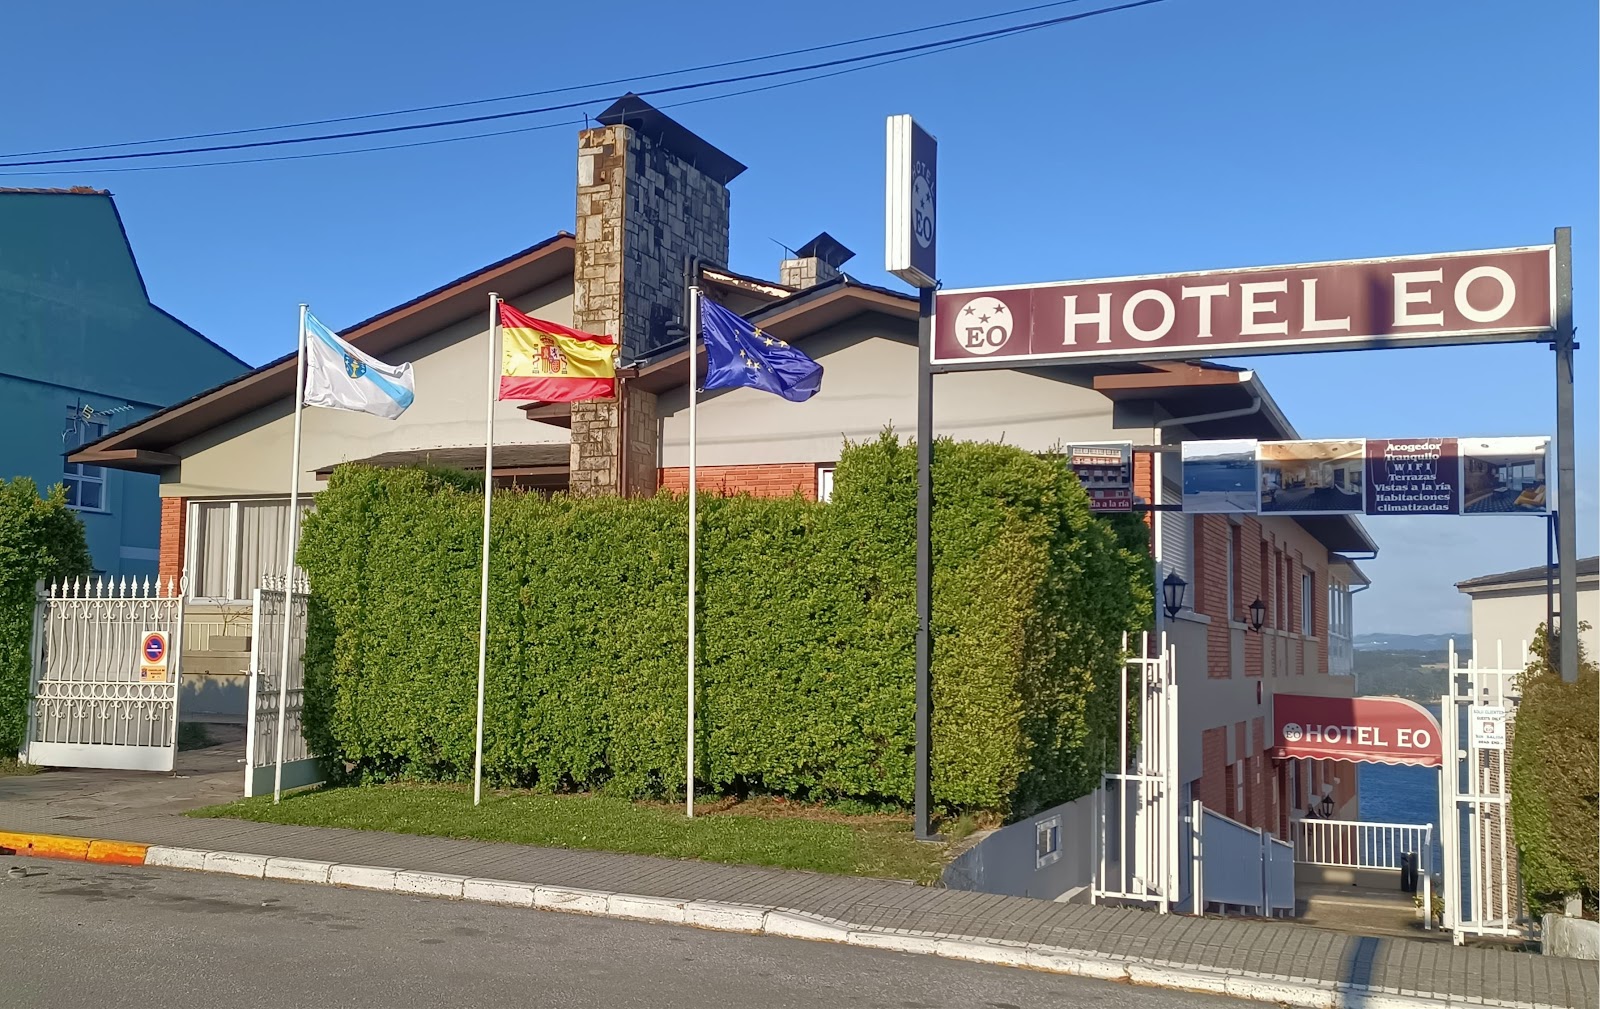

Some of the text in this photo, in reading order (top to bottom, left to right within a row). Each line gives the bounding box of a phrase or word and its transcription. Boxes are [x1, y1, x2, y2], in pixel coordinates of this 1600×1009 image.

[912, 160, 935, 196] HOTEL
[915, 208, 932, 242] EO
[1062, 265, 1516, 346] HOTEL EO
[965, 324, 1008, 348] EO
[1387, 442, 1442, 452] Acogedor
[1385, 453, 1440, 462] Tranquilo
[1388, 473, 1437, 481] Terrazas
[1375, 483, 1409, 492] Vistas
[1421, 483, 1433, 491] la
[1435, 482, 1451, 490] ría
[1376, 494, 1450, 502] Habitaciones
[1286, 730, 1301, 739] EO
[1305, 723, 1431, 749] HOTEL EO
